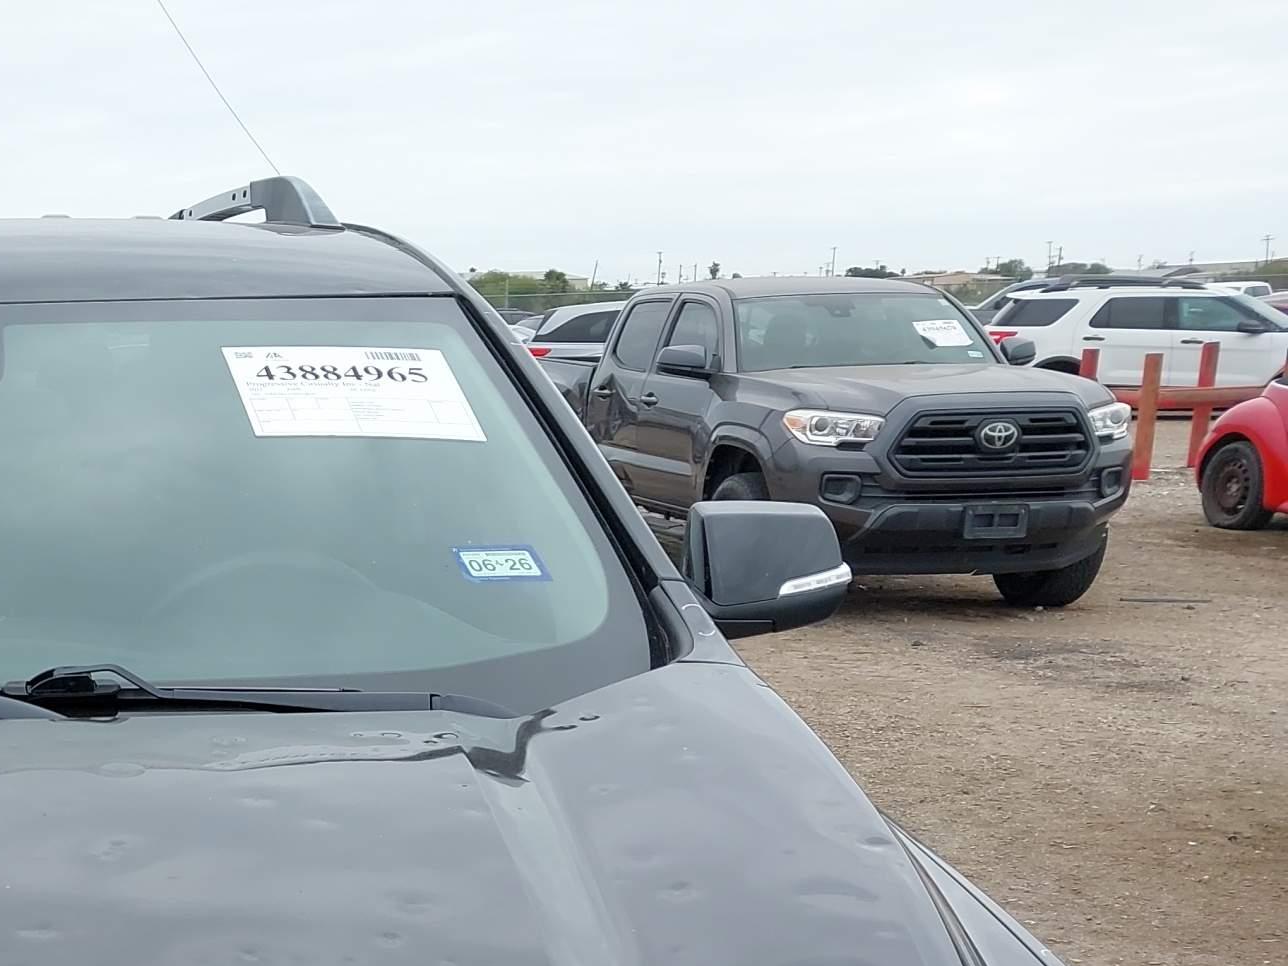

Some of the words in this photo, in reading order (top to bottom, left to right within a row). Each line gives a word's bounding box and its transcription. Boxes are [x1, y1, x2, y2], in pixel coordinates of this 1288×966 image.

[256, 365, 428, 383] 43884965
[468, 559, 497, 572] 06
[504, 558, 532, 571] 26
